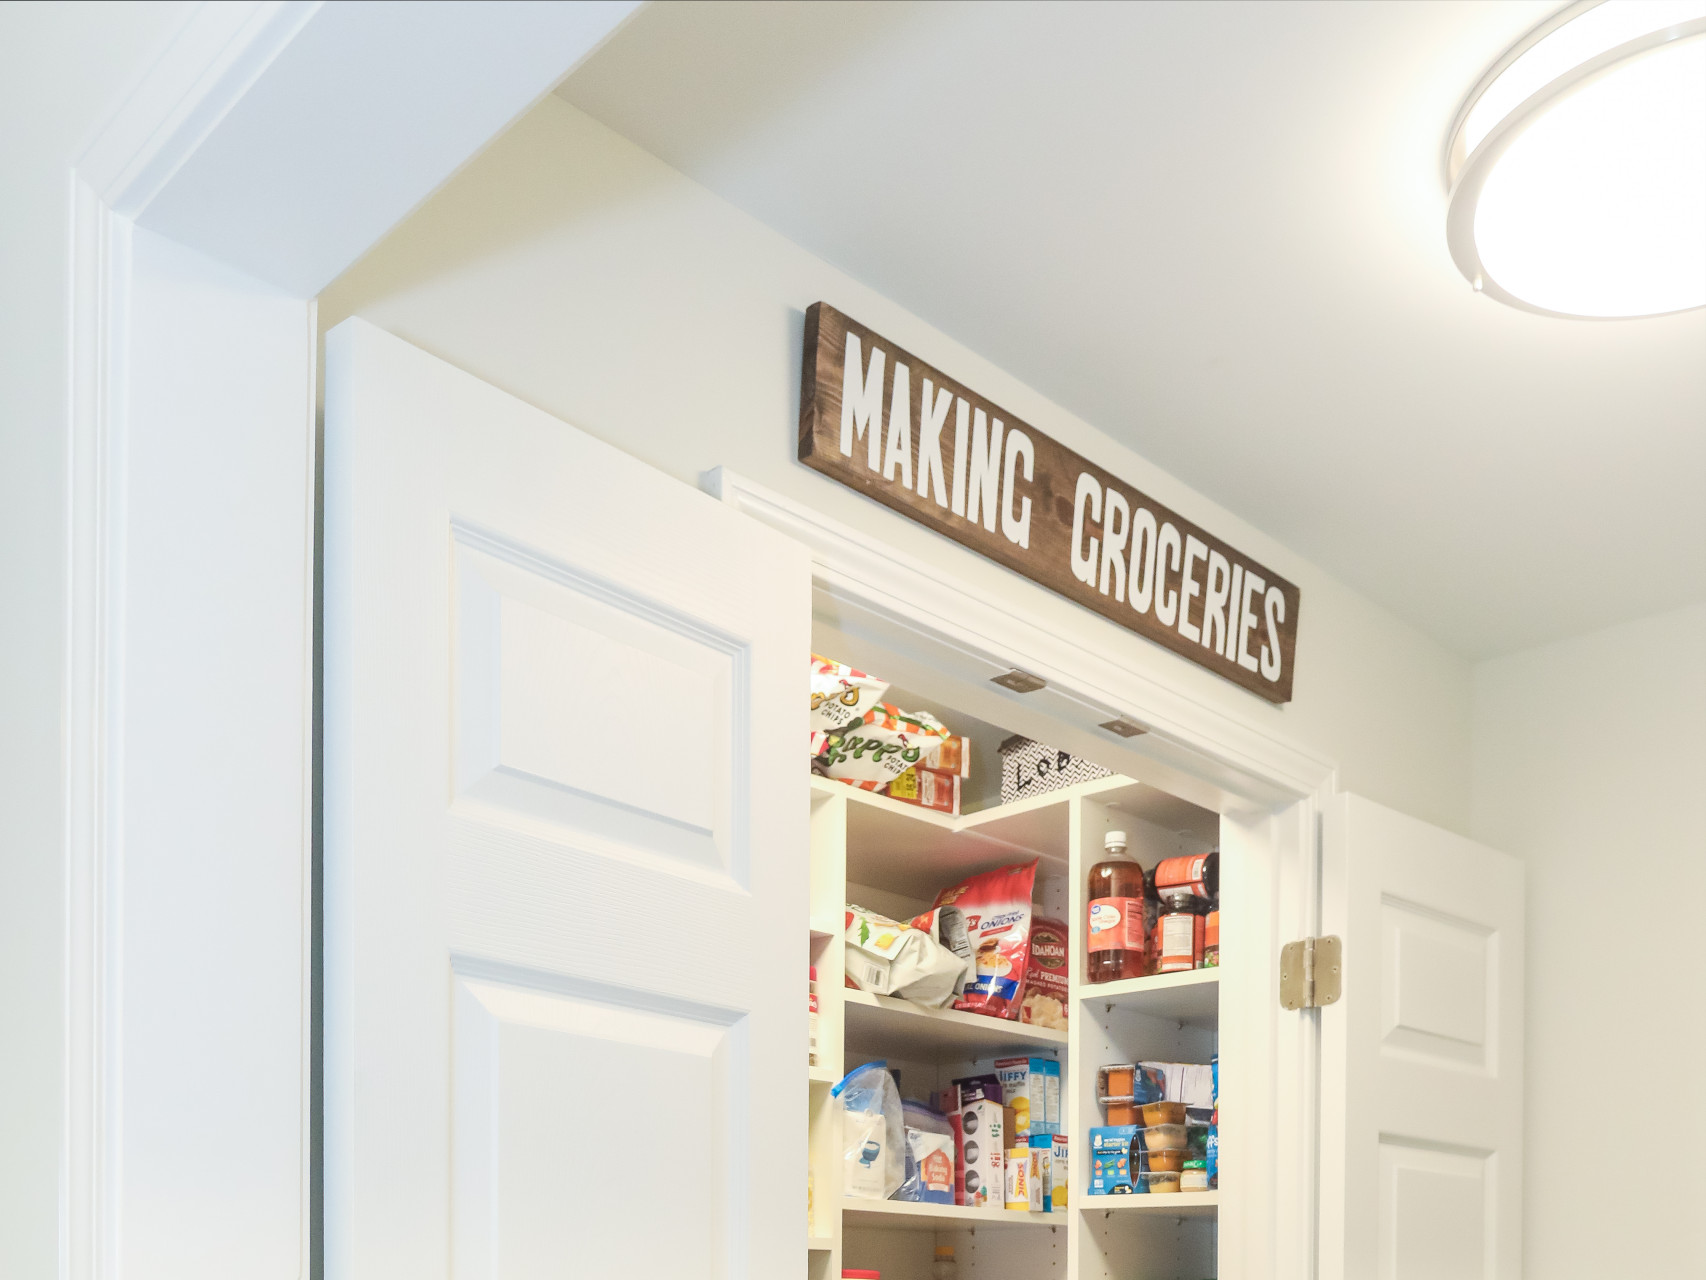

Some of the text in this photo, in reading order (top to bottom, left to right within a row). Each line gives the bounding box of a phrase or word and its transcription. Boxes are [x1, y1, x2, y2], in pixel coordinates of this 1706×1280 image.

[840, 331, 1285, 682] MAKING GROCERIES
[825, 701, 851, 719] POTATO
[883, 762, 902, 775] CHIP
[886, 755, 908, 769] POTAT
[981, 914, 1025, 930] ONIONS
[1032, 943, 1065, 957] IDAHOAN
[1017, 1162, 1025, 1197] SONIC
